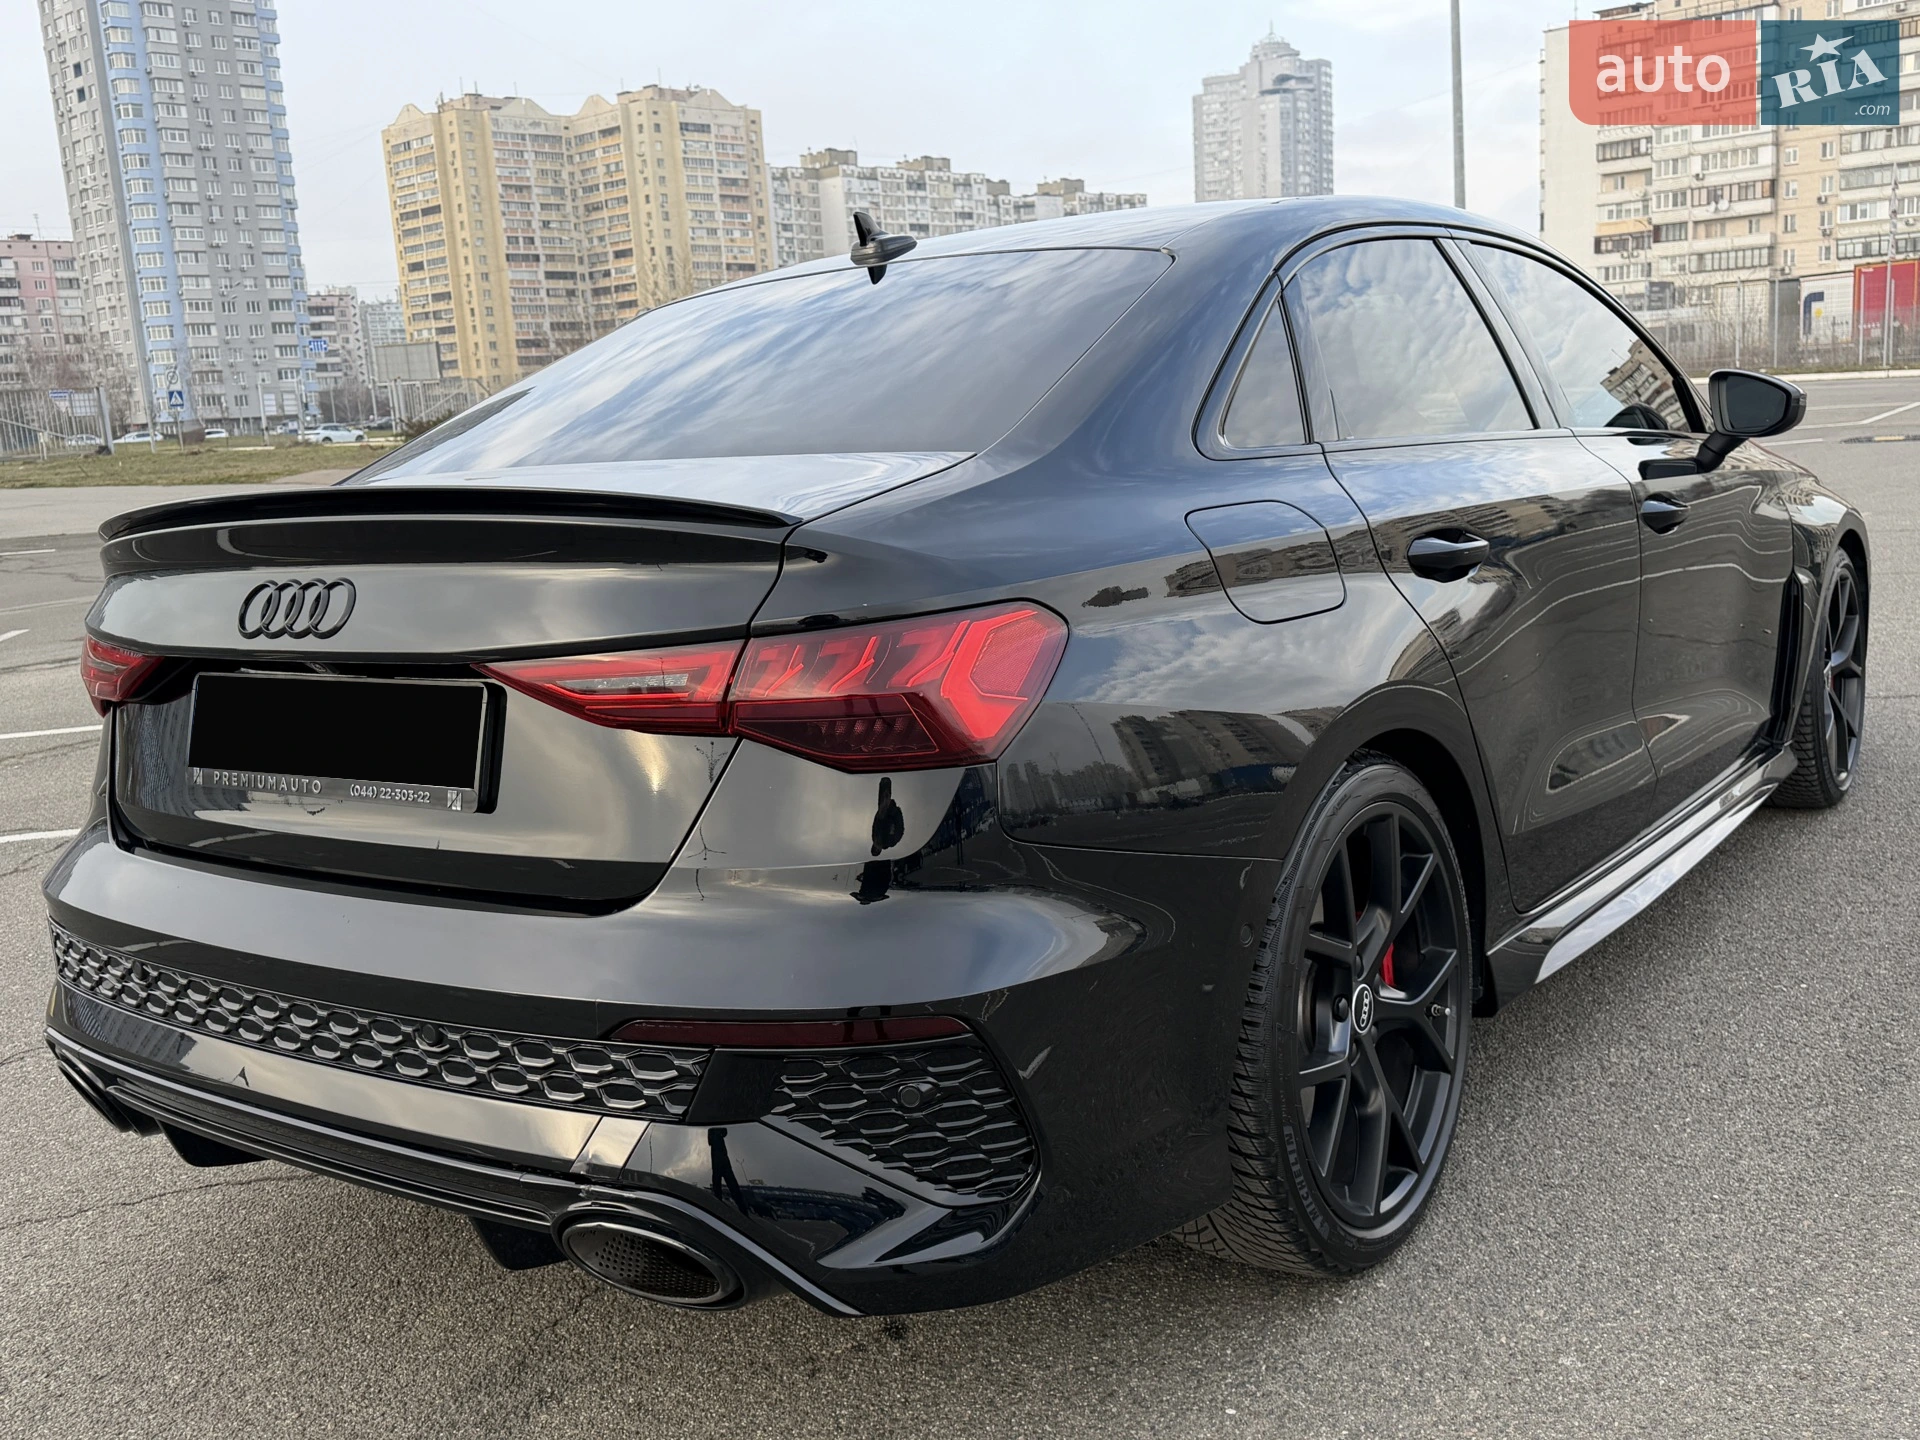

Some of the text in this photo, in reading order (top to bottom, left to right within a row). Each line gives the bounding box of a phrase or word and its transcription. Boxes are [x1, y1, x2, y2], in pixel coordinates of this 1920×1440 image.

[213, 770, 430, 803] PREMIUMAUTO (044) 22-303-22
[1284, 1130, 1322, 1224] MICHELIN
